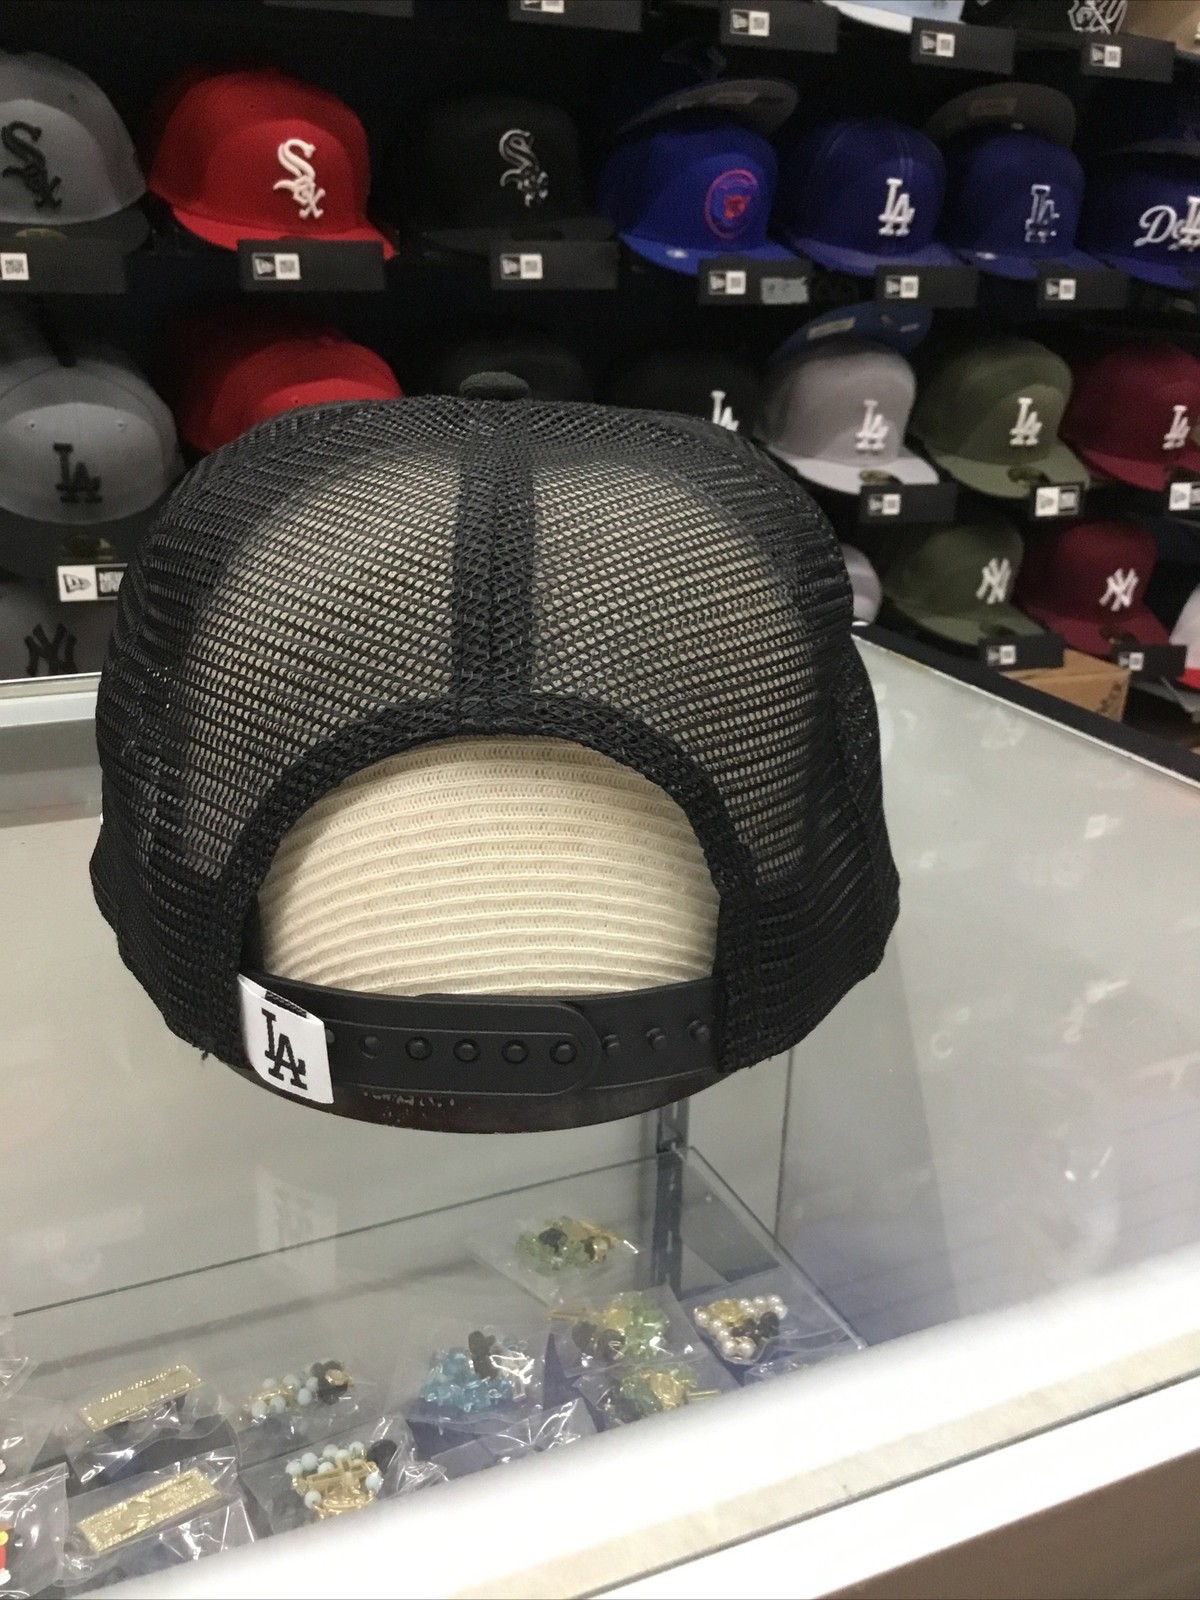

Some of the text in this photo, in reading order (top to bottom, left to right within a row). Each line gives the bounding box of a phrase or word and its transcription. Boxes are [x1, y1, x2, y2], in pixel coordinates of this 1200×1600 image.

[878, 178, 916, 237] LA
[1025, 184, 1060, 243] LA
[855, 400, 890, 451] LA
[1010, 397, 1043, 447] LA
[1163, 405, 1191, 450] LA
[53, 443, 102, 502] LA
[976, 557, 1011, 604] NY
[1099, 567, 1139, 610] NY
[260, 1007, 308, 1091] LA
